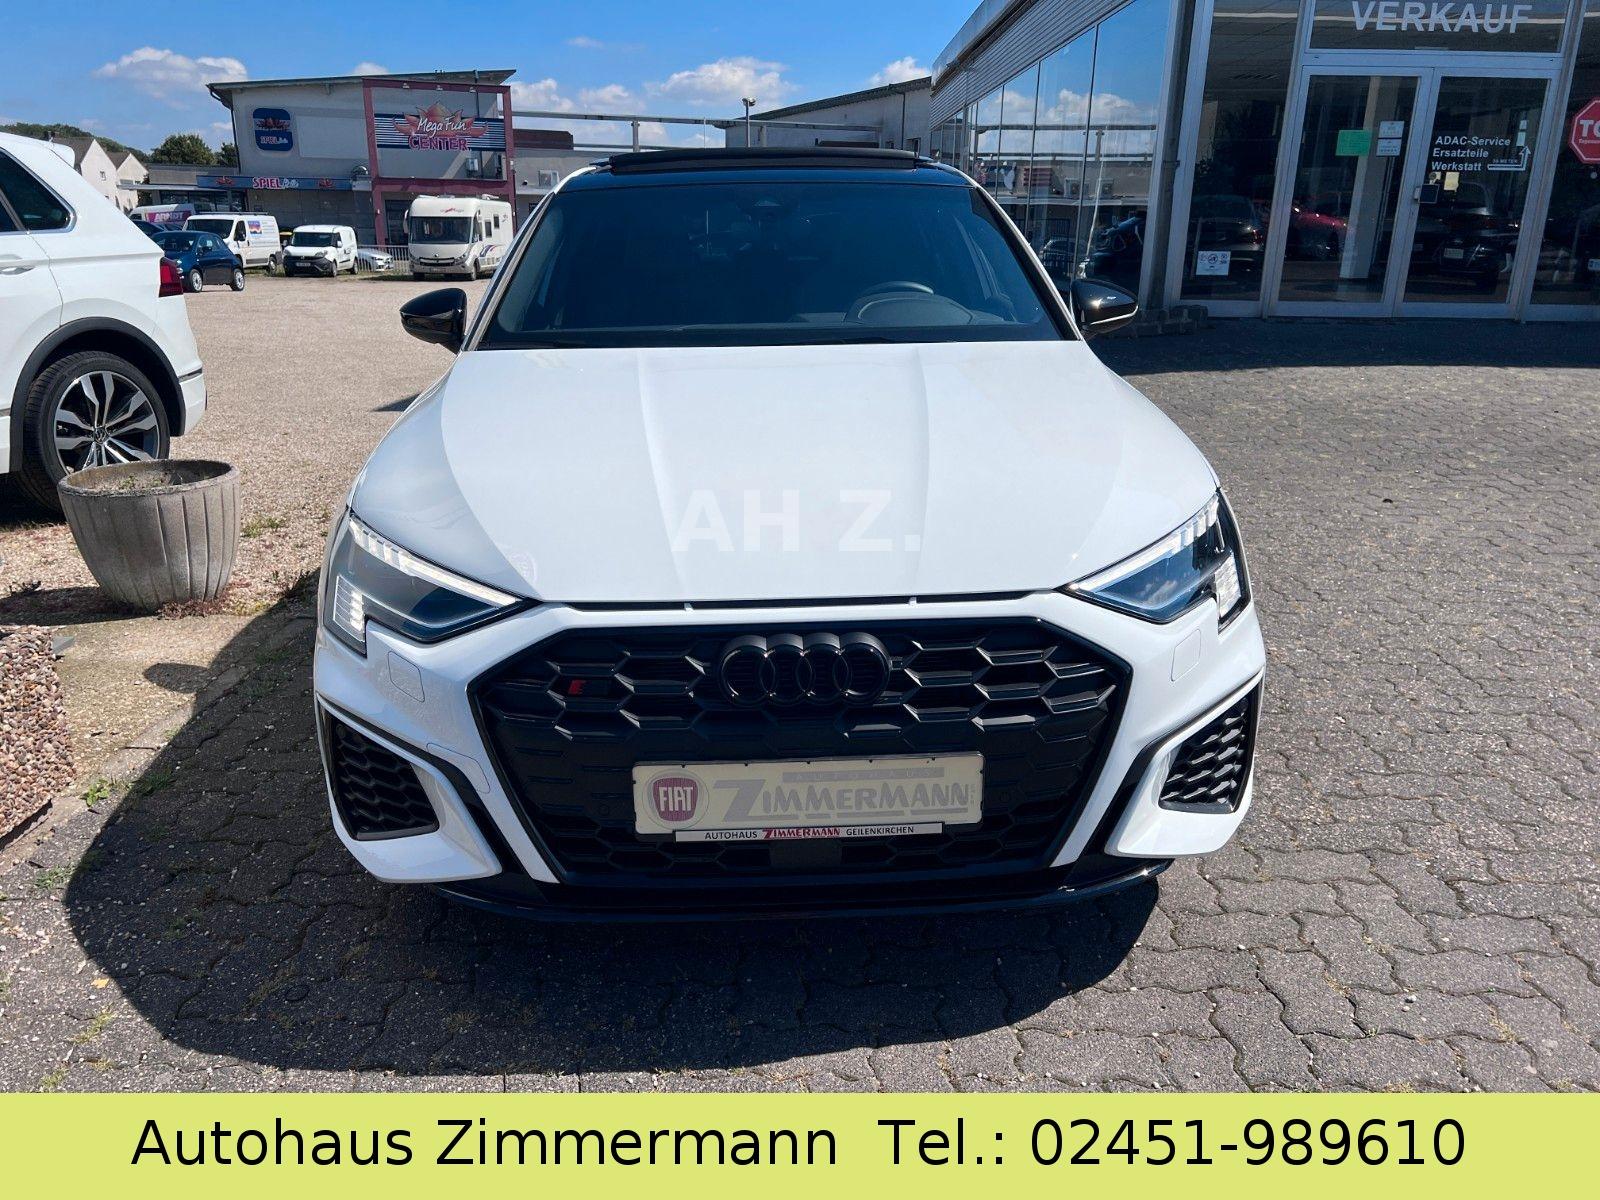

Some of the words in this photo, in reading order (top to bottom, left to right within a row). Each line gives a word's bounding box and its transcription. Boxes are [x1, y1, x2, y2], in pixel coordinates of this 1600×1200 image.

[1352, 1, 1532, 33] VERKAUF
[417, 118, 443, 137] Mega
[444, 116, 467, 131] Fun
[408, 133, 468, 150] CENTER
[1435, 135, 1511, 146] ADAC-Service
[1433, 148, 1489, 158] Ersatzteile
[1431, 161, 1482, 171] Werkstatt
[252, 177, 283, 189] SPIEL
[659, 786, 693, 812] FIAT
[713, 779, 968, 822] ZIMMERMANN
[705, 831, 757, 840] AUTOHAUS
[762, 827, 840, 840] ZIMMERMANN
[846, 826, 914, 836] GEILENKIRCHEN
